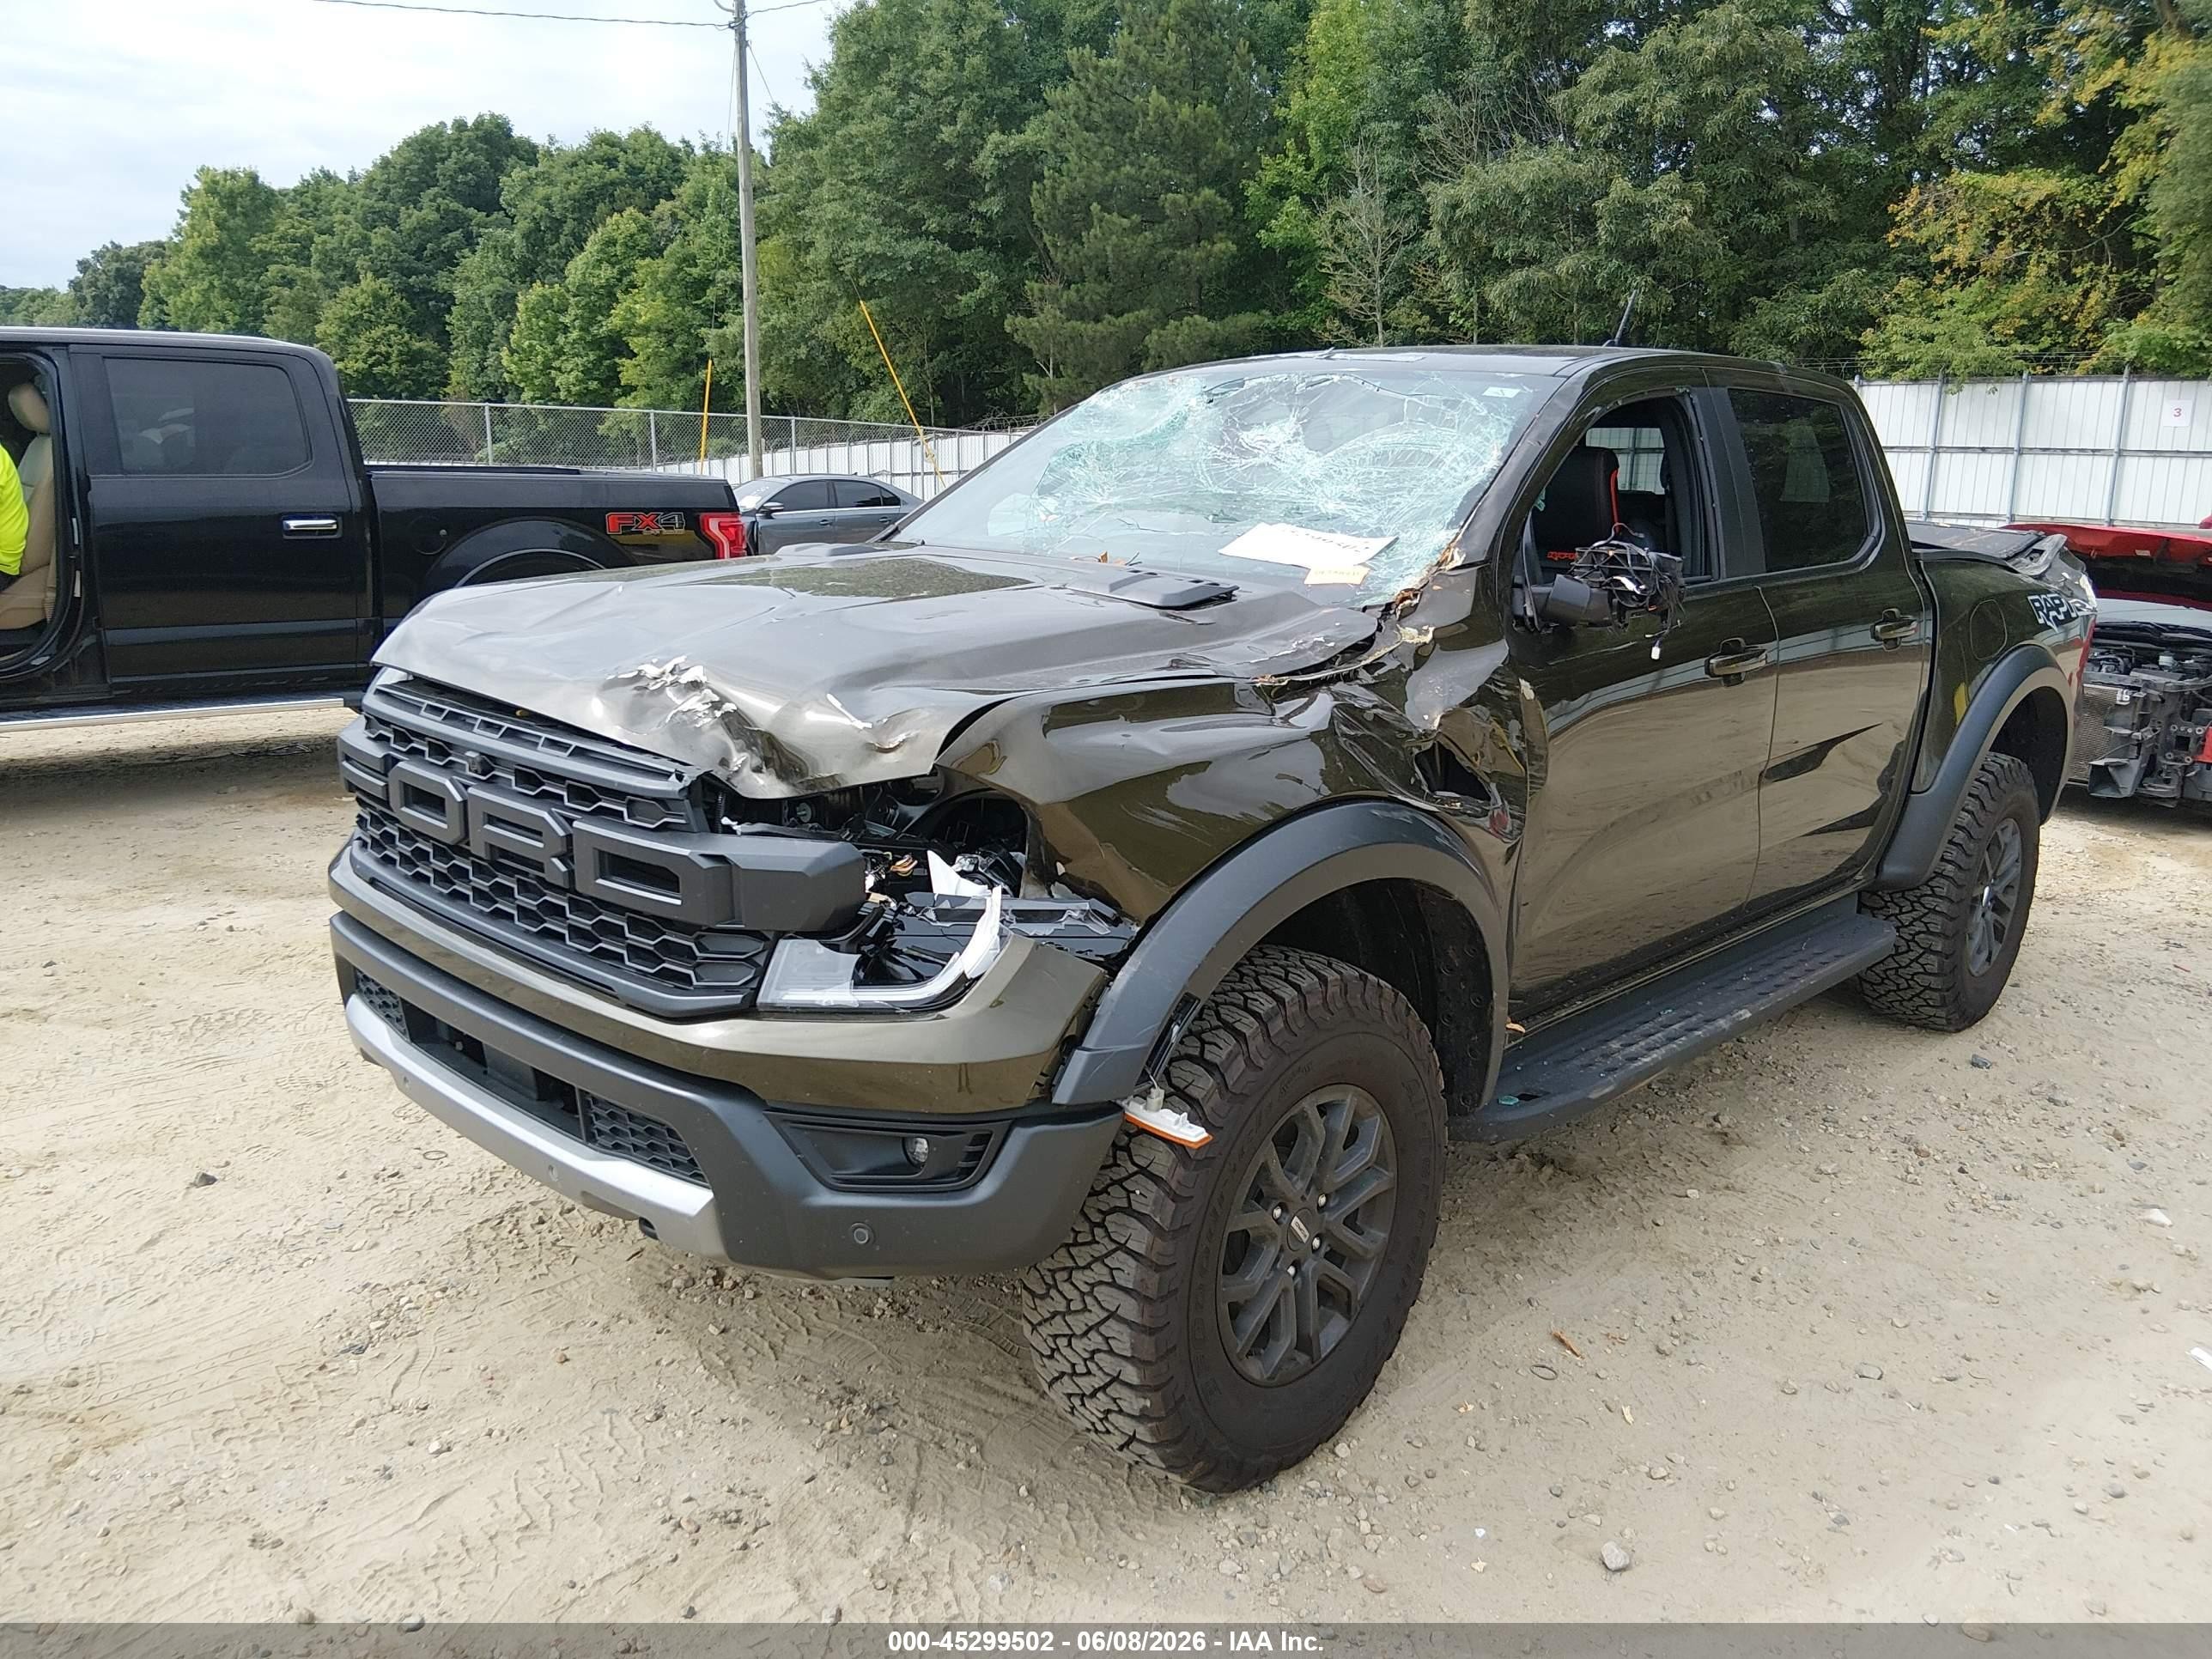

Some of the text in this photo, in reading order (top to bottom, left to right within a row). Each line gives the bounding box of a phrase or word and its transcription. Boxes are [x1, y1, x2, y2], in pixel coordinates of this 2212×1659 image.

[2173, 407, 2182, 417] 3
[605, 512, 685, 534] FX4
[2027, 593, 2097, 633] RAPT
[337, 734, 735, 924] FORD
